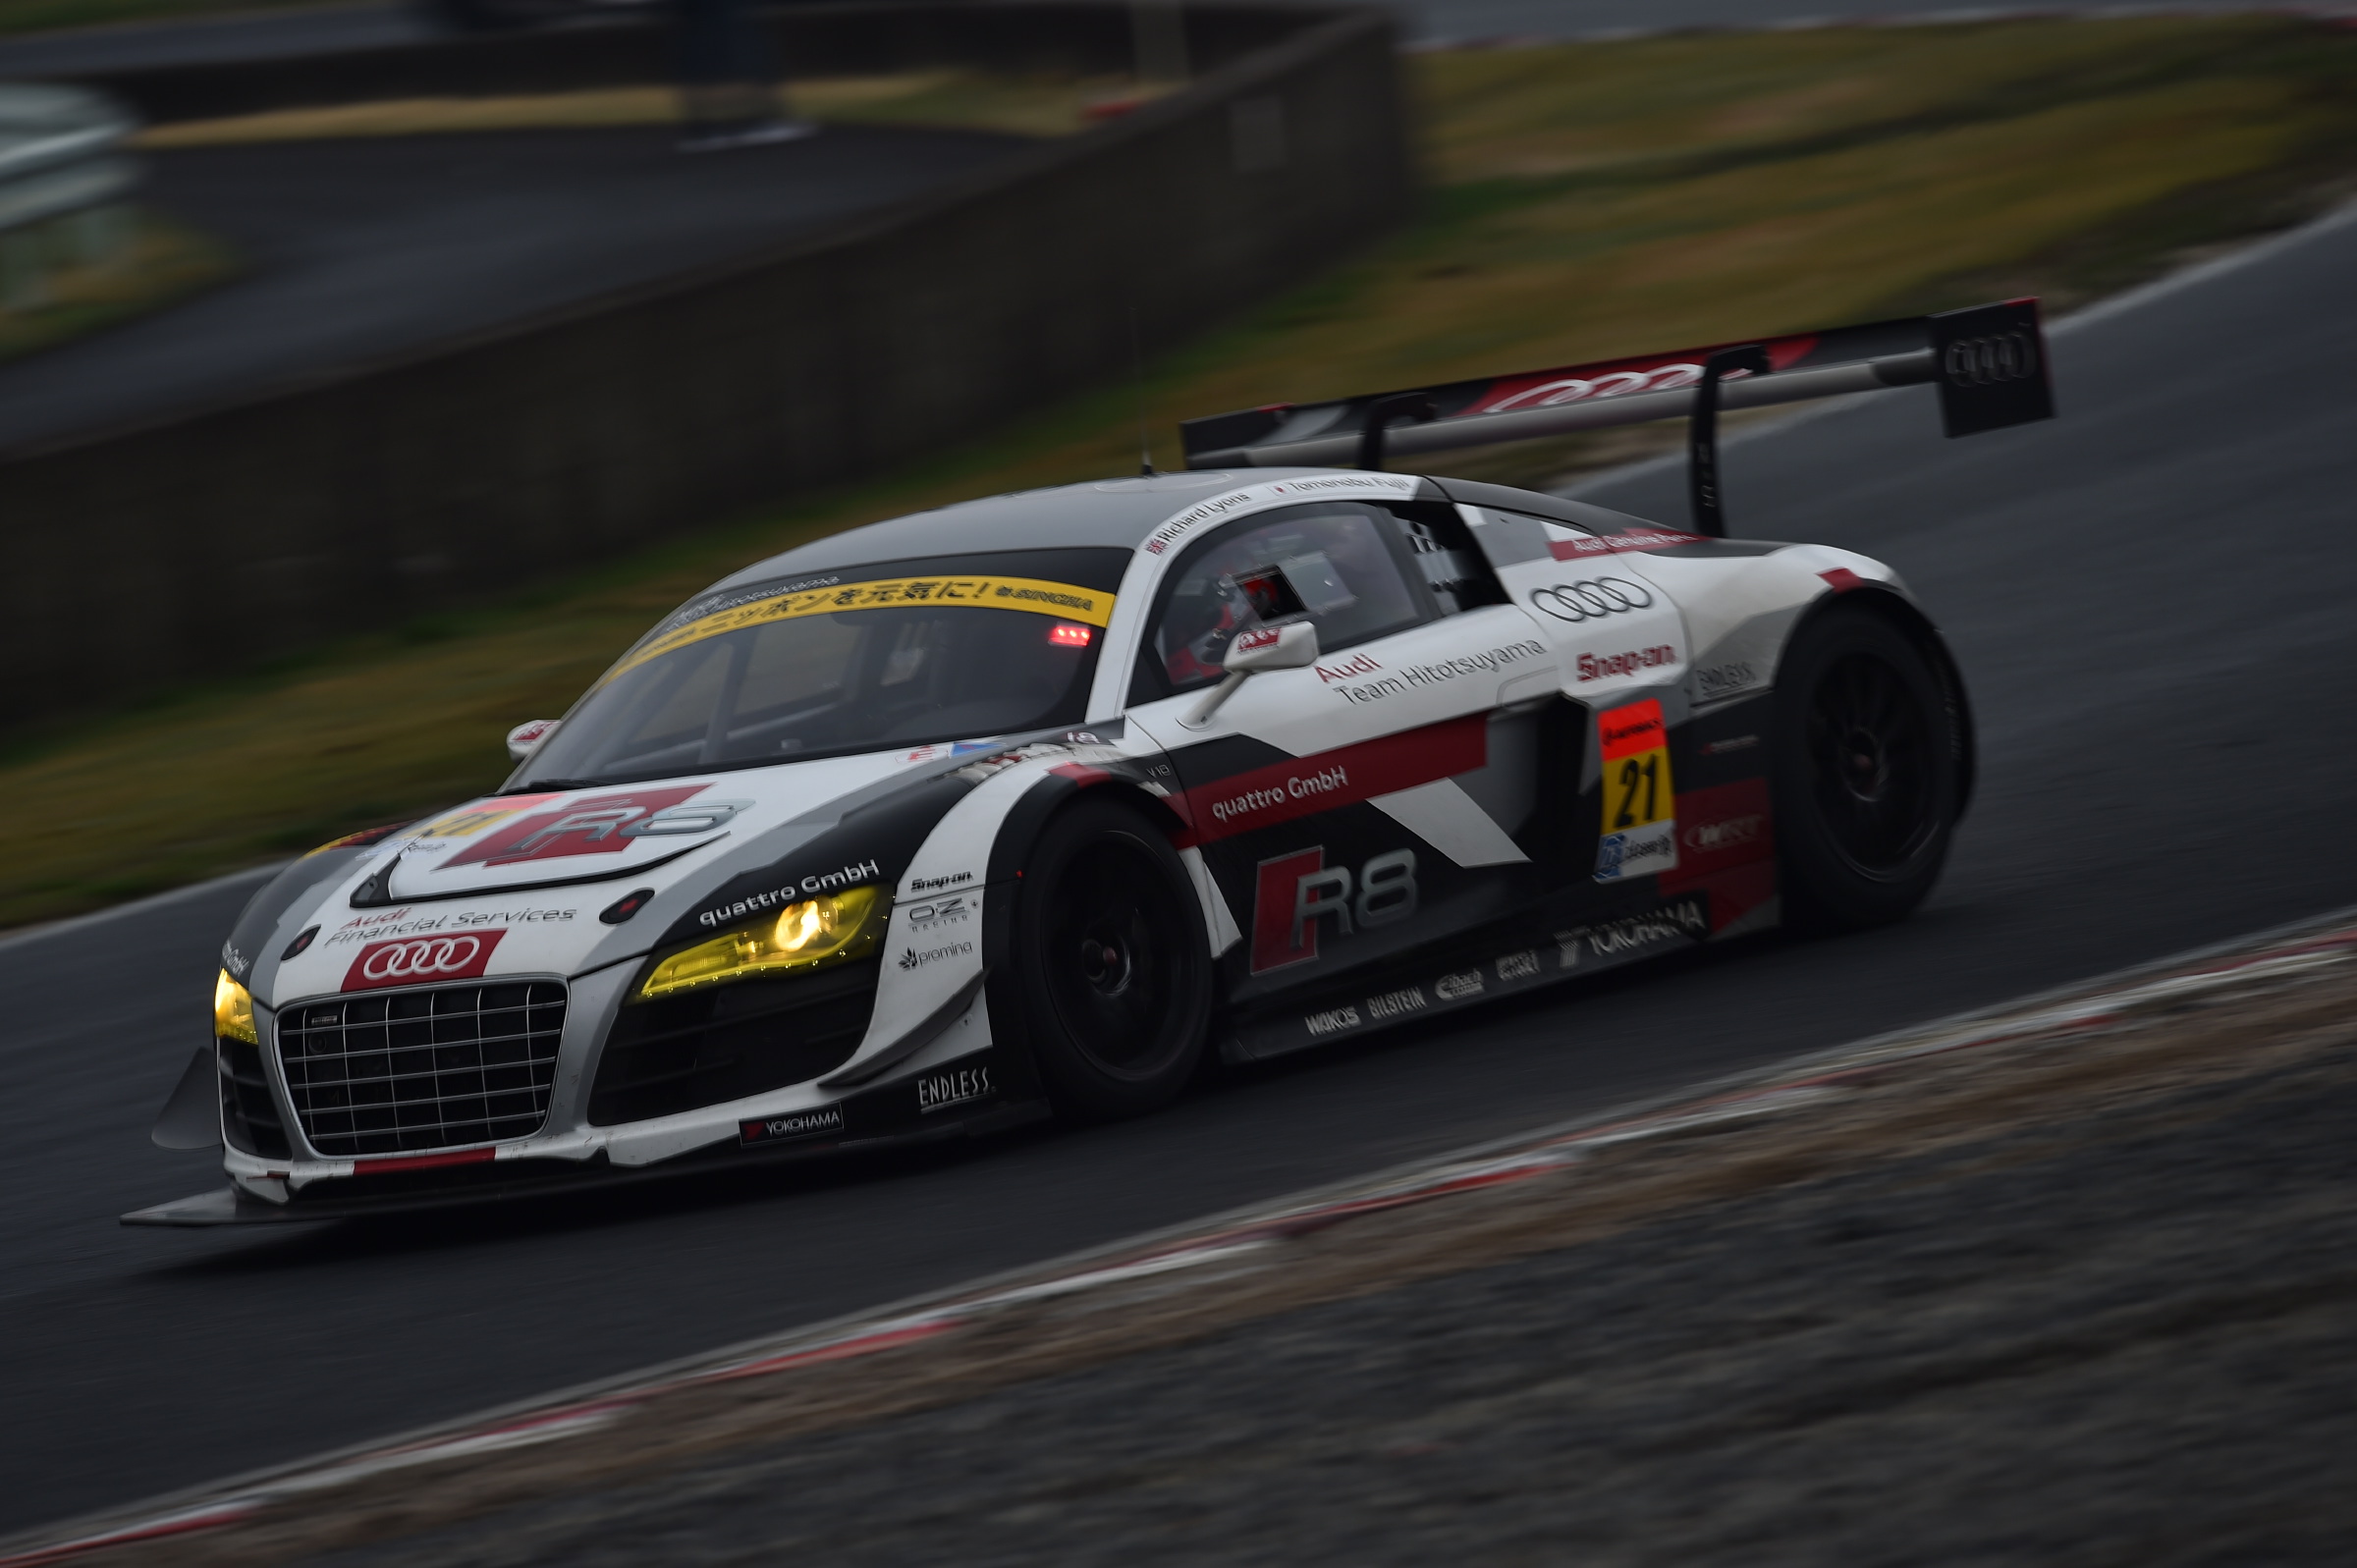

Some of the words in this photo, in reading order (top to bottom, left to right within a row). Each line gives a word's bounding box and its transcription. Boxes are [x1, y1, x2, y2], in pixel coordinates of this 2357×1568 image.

[1158, 504, 1209, 543] Richard
[1209, 492, 1250, 514] Lyons
[1013, 589, 1094, 612] SINGHA
[1314, 653, 1383, 683] Audi
[1334, 675, 1405, 706] Team
[1406, 637, 1548, 688] Hitotsuyama
[1212, 785, 1287, 824] quattro
[1287, 765, 1349, 800] GmbH
[1613, 754, 1659, 829] 21
[505, 799, 756, 852] R8
[699, 884, 796, 927] quattro
[800, 858, 881, 894] GmbH
[911, 871, 973, 892] Snap-on
[1290, 848, 1418, 949] R8
[324, 915, 448, 948] Financial
[452, 907, 577, 929] Services
[340, 906, 412, 930] Audi
[1367, 987, 1428, 1019] BILSTEIN
[917, 1066, 991, 1108] ENDLESS
[766, 1111, 841, 1136] YOKOHAMA
